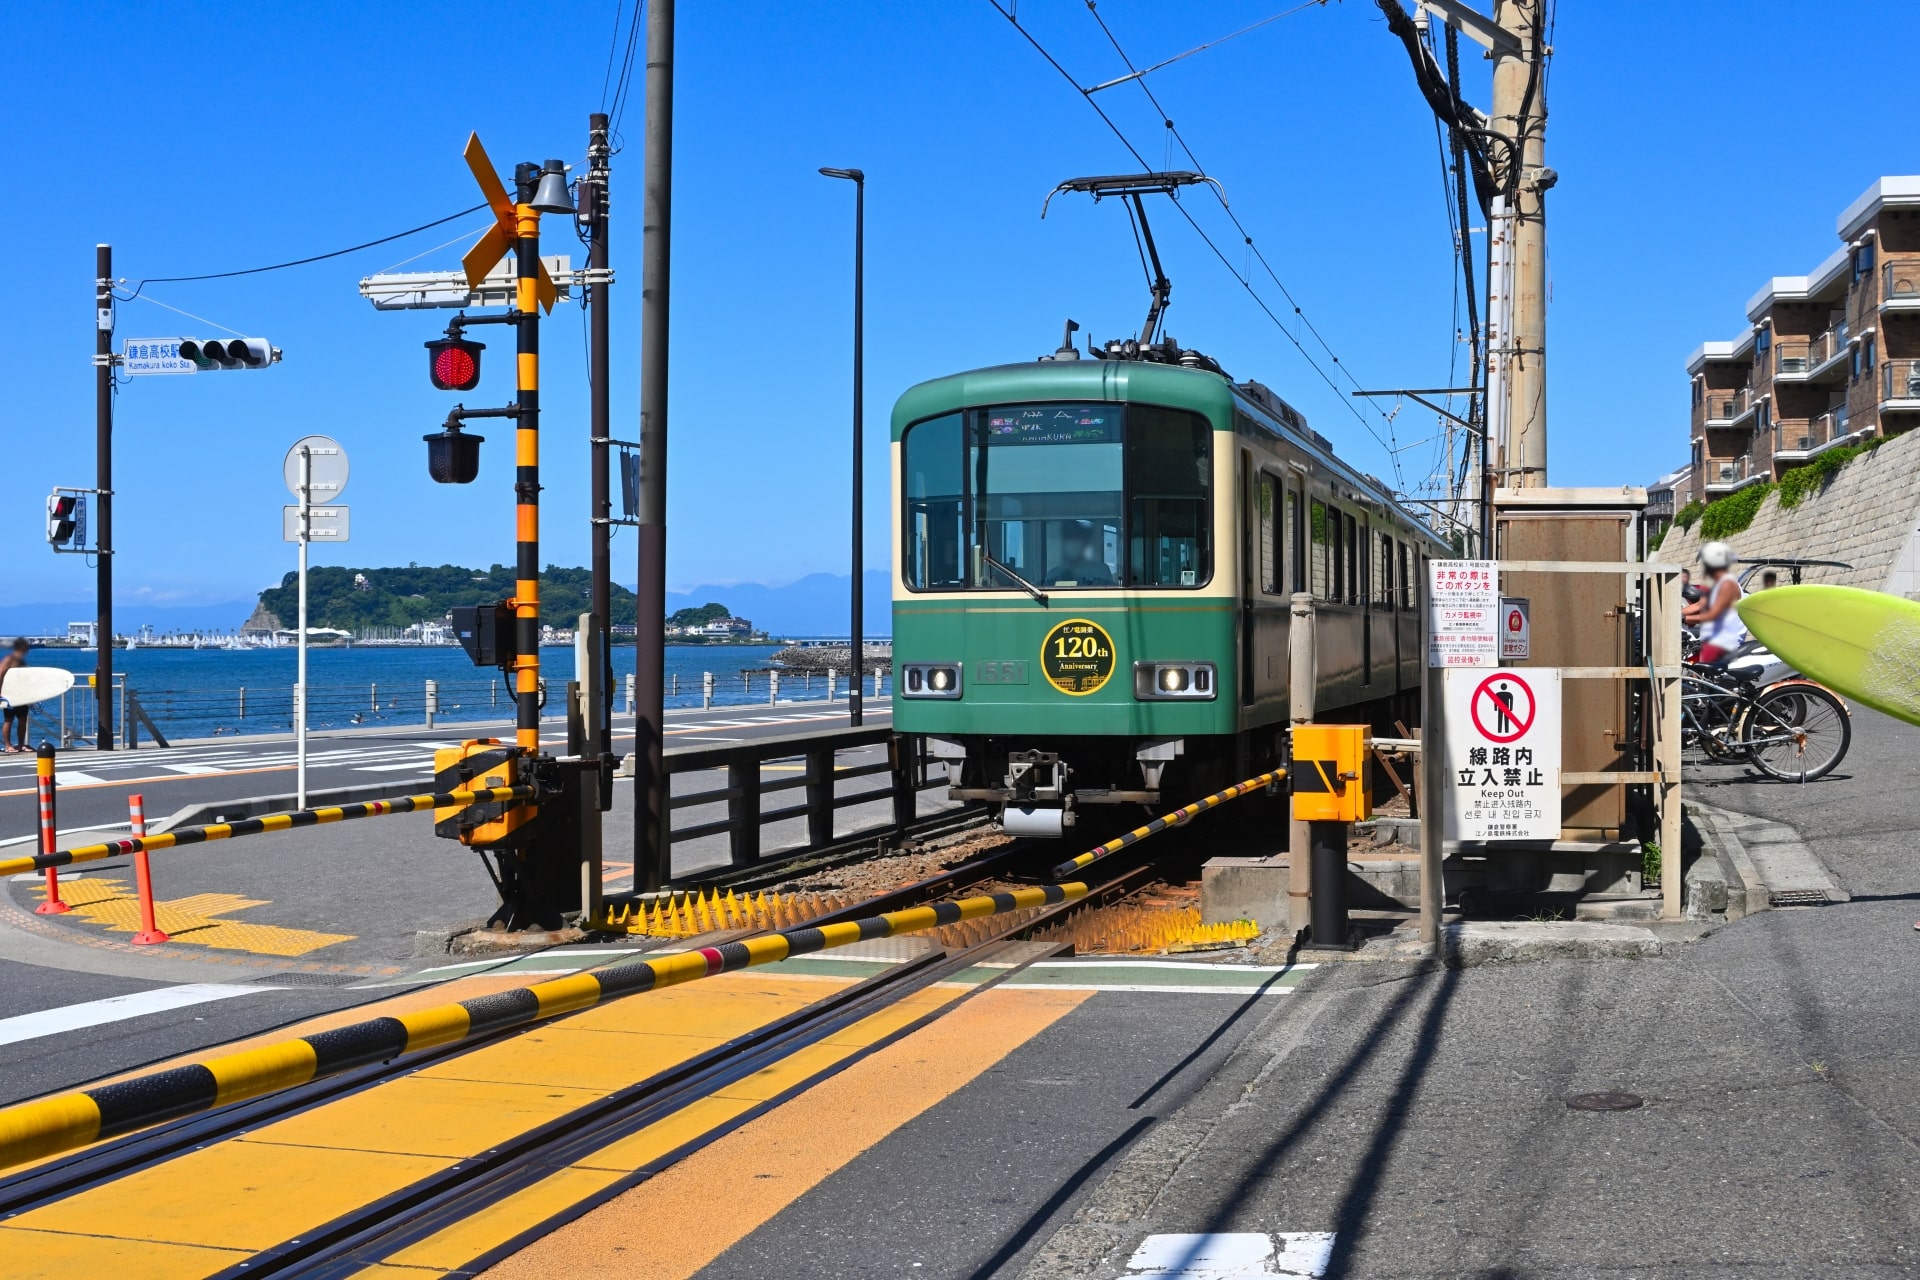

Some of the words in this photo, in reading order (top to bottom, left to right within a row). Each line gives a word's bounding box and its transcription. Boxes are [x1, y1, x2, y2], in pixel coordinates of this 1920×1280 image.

[128, 344, 180, 360] 鎌倉高校駅
[129, 361, 160, 370] Kamakura
[162, 361, 177, 369] koko
[1436, 571, 1489, 580] 非常の際は
[1436, 581, 1491, 591] このボタンを
[1445, 611, 1482, 619] カメラ監視中
[1054, 636, 1108, 658] 120th
[1059, 662, 1097, 671] Anniversary
[976, 662, 1024, 683] 1551
[1469, 747, 1532, 766] 線路内
[1457, 768, 1544, 787] 立入禁止
[1481, 789, 1504, 799] Keep
[1507, 789, 1524, 797] Out
[1464, 810, 1482, 819] 선로
[1488, 810, 1497, 819] 내
[1503, 810, 1520, 819] 진입
[1524, 810, 1542, 819] 금지
